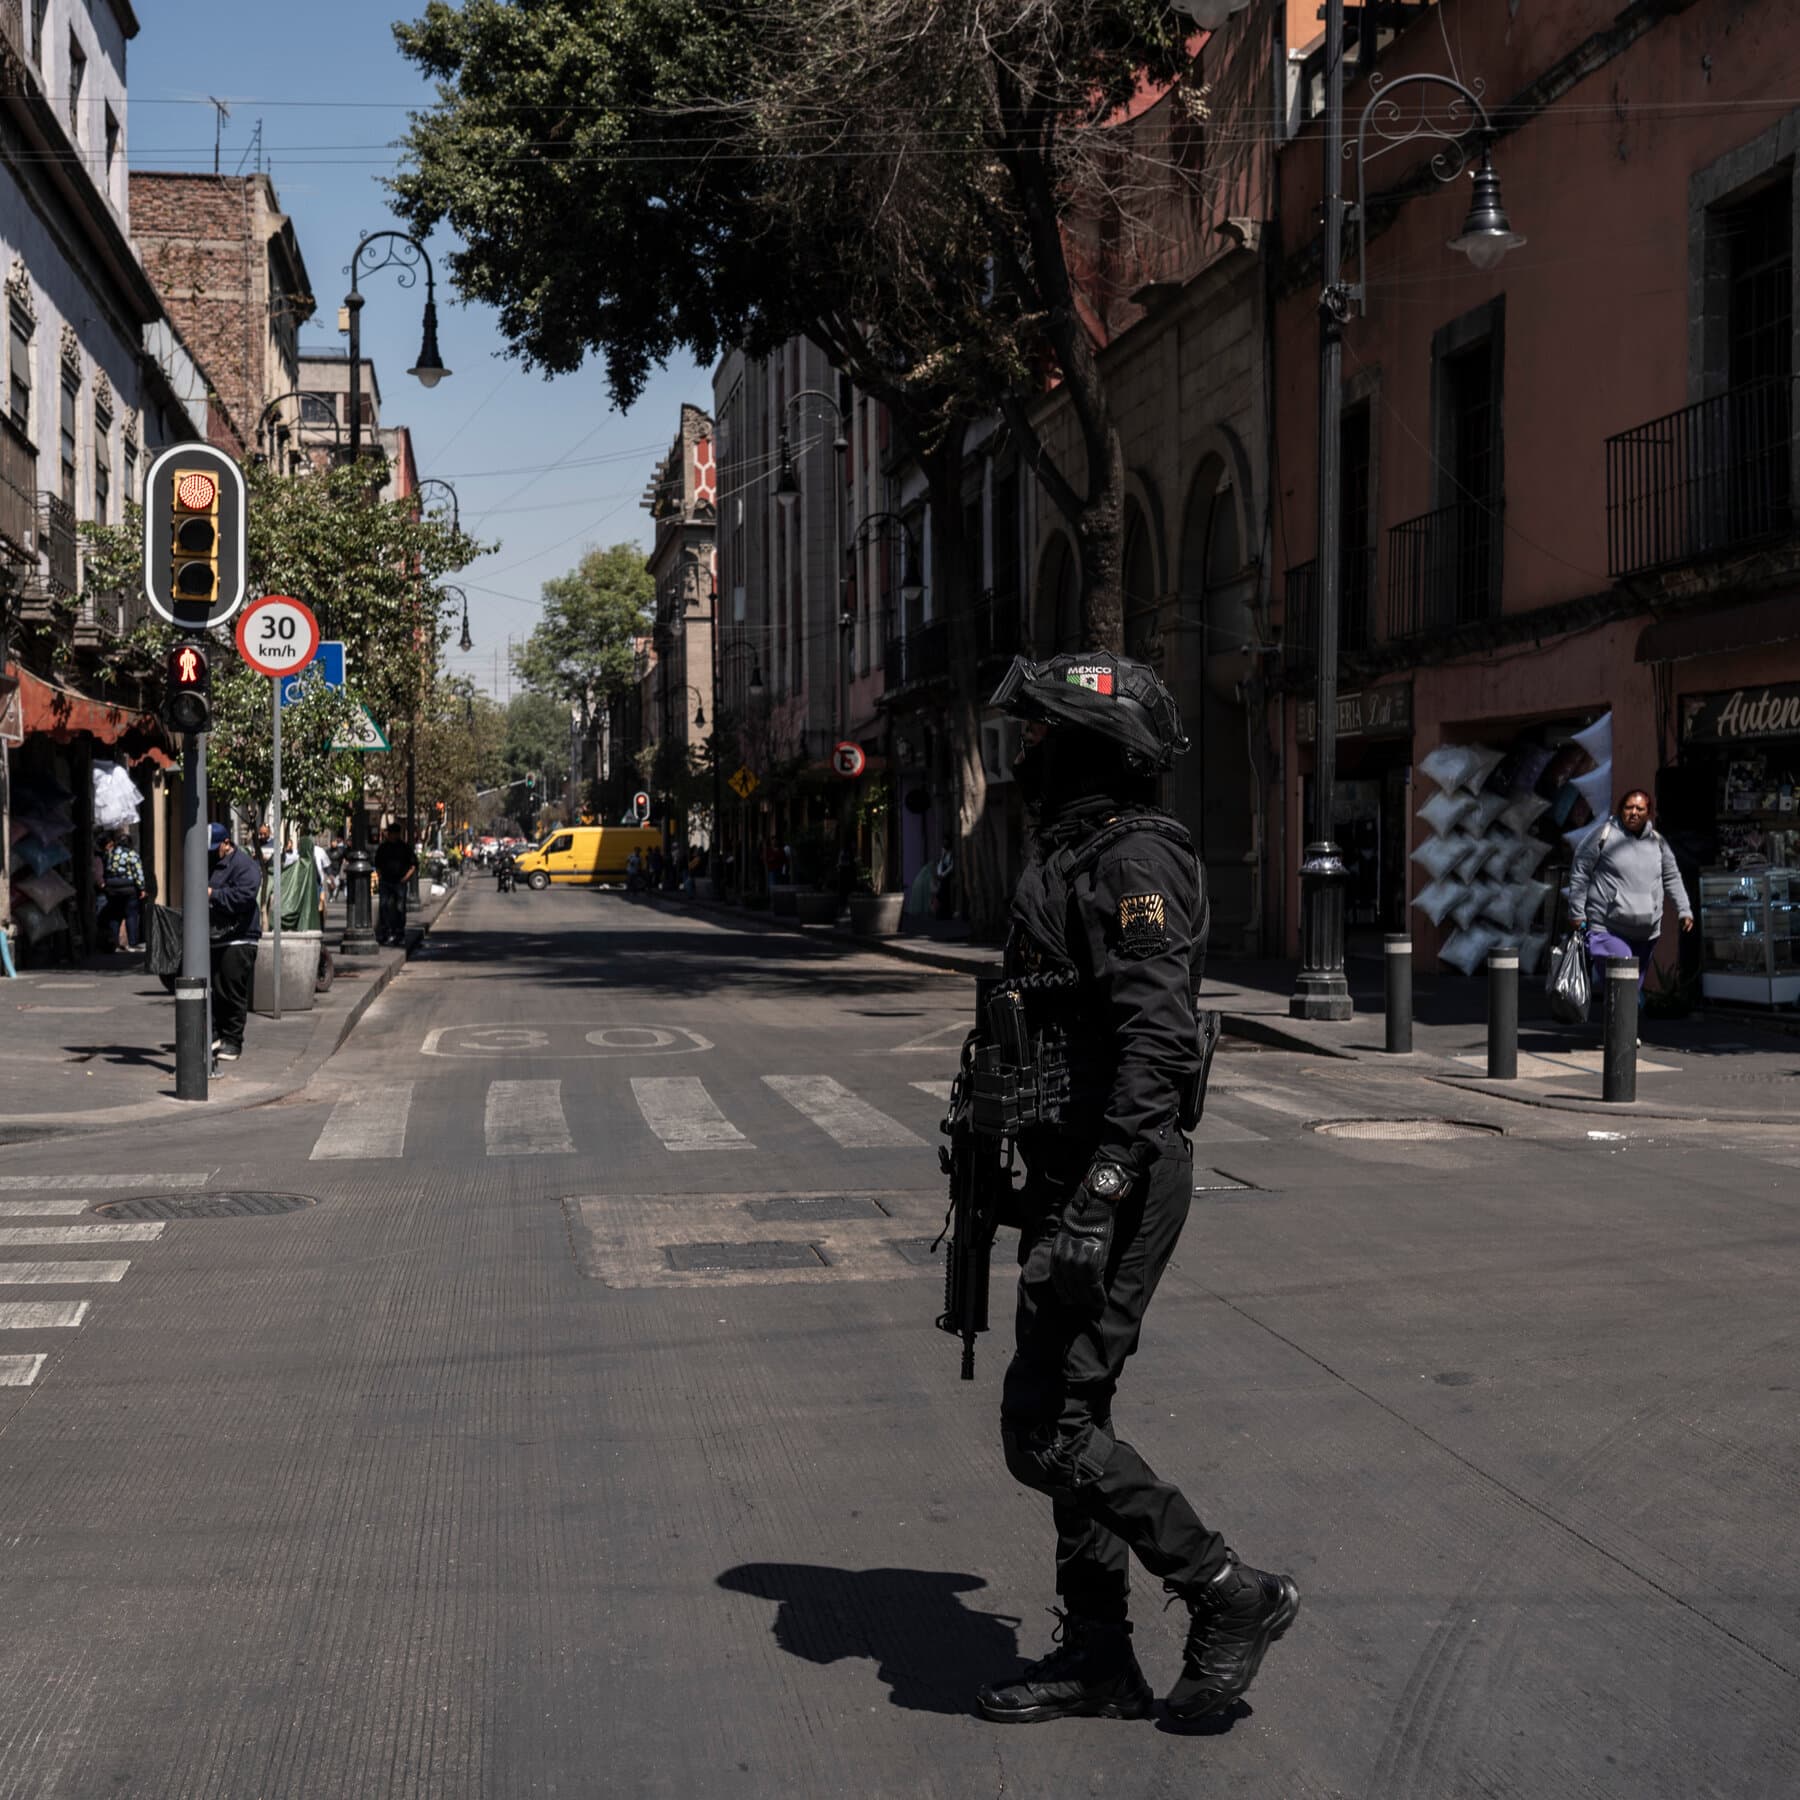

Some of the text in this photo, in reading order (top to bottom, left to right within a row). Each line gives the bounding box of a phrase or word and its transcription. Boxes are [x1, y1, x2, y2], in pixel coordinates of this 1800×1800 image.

[261, 616, 295, 639] 30
[259, 643, 296, 657] km/h
[1717, 686, 1800, 736] Auten
[459, 1028, 676, 1050] 30
